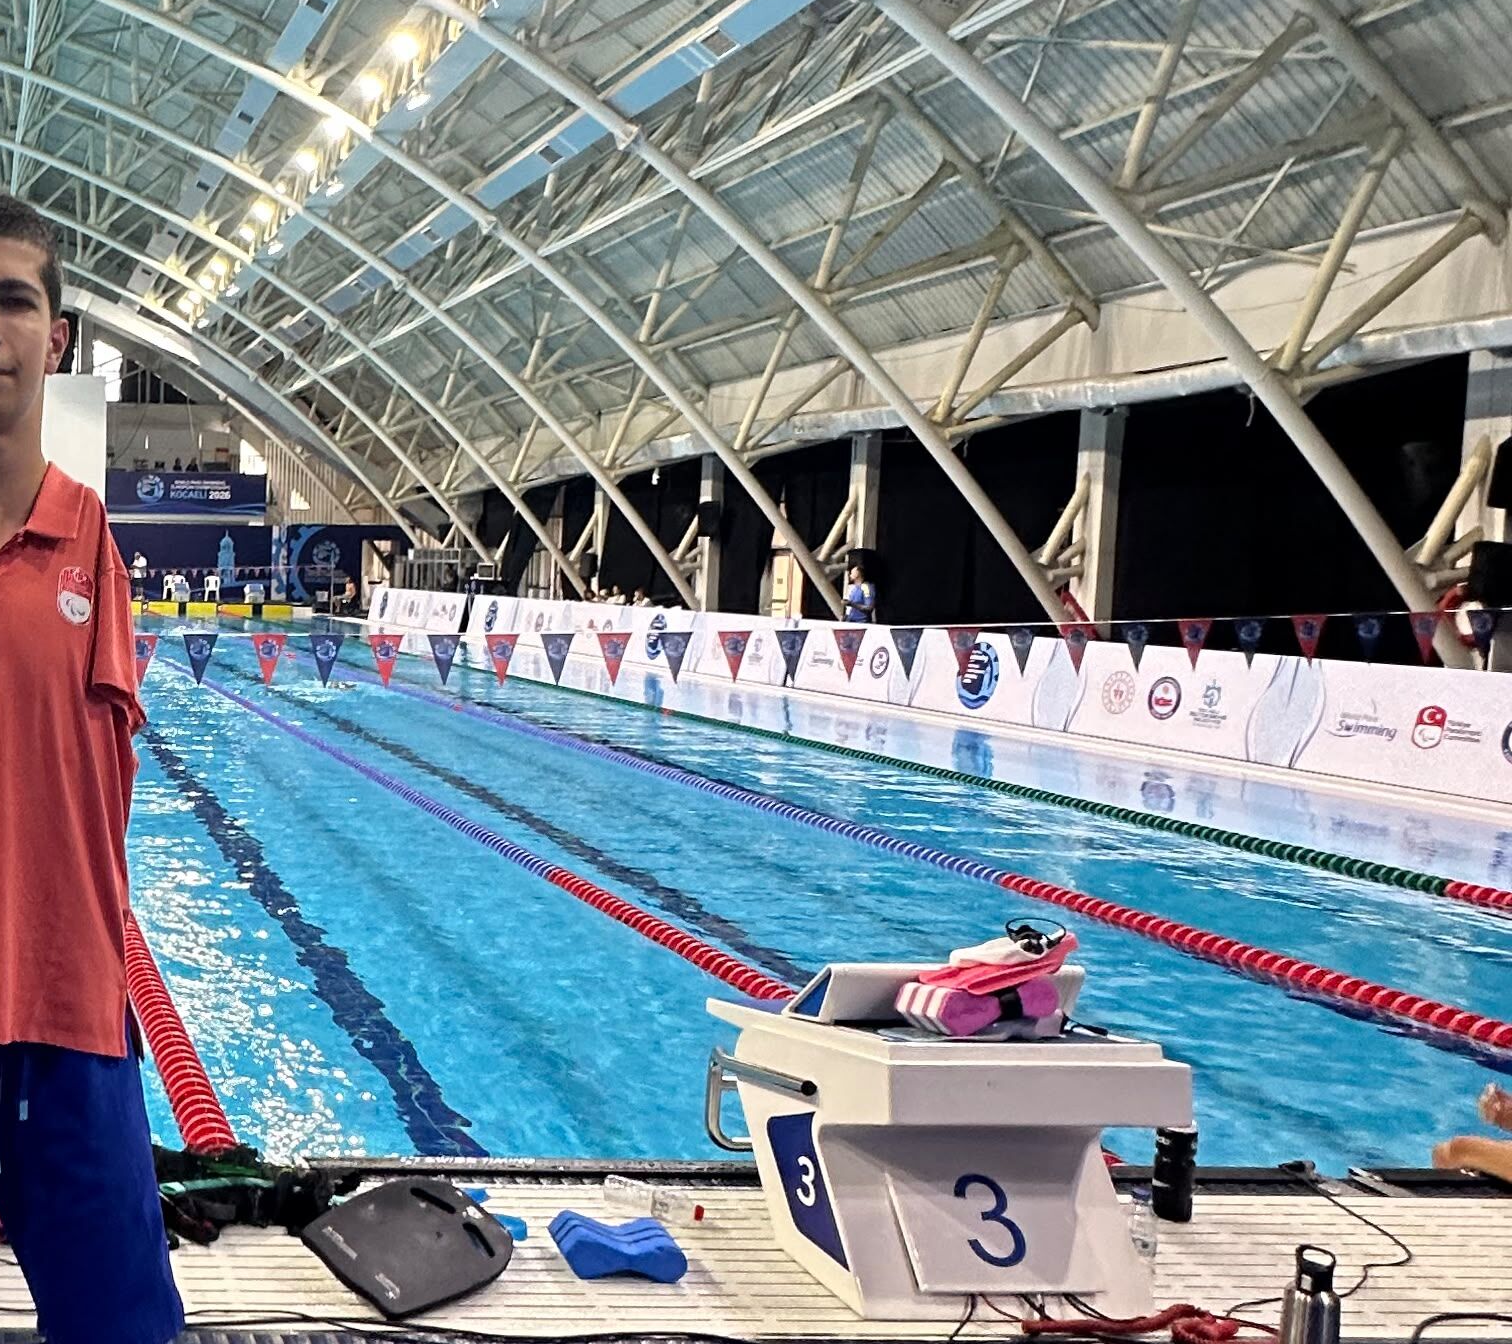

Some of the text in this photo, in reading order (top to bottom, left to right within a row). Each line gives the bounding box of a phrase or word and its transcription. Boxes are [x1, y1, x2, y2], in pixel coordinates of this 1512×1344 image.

[1336, 719, 1398, 742] Swimming
[795, 1155, 816, 1208] 3
[953, 1172, 1027, 1269] 3
